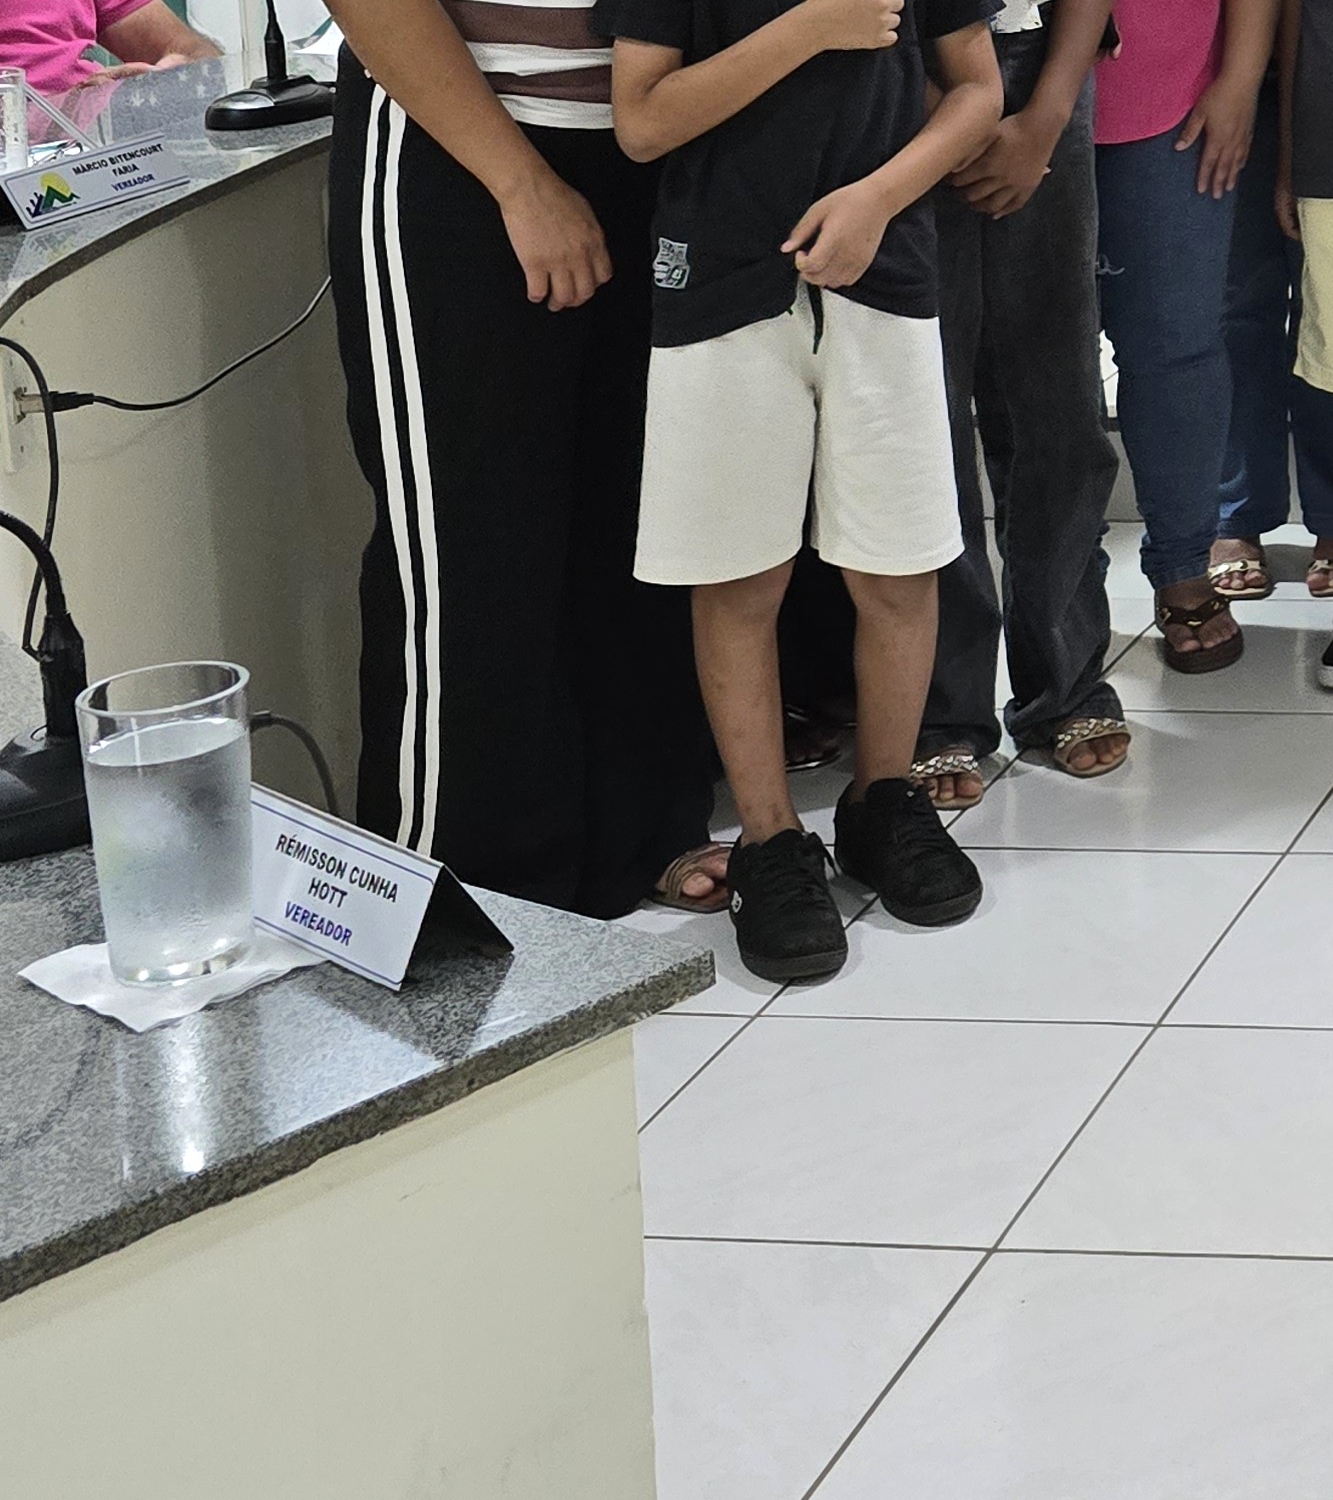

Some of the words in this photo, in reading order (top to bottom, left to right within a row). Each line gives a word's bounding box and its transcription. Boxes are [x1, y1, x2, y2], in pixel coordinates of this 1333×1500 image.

[110, 143, 163, 165] BITENCOURT
[111, 174, 155, 191] VEREADOR
[112, 164, 139, 176] FARIA
[275, 833, 348, 880] RÉMISSON
[349, 866, 398, 903] CUNHA
[308, 877, 348, 908] HOTT
[285, 901, 353, 946] VEREADOR
